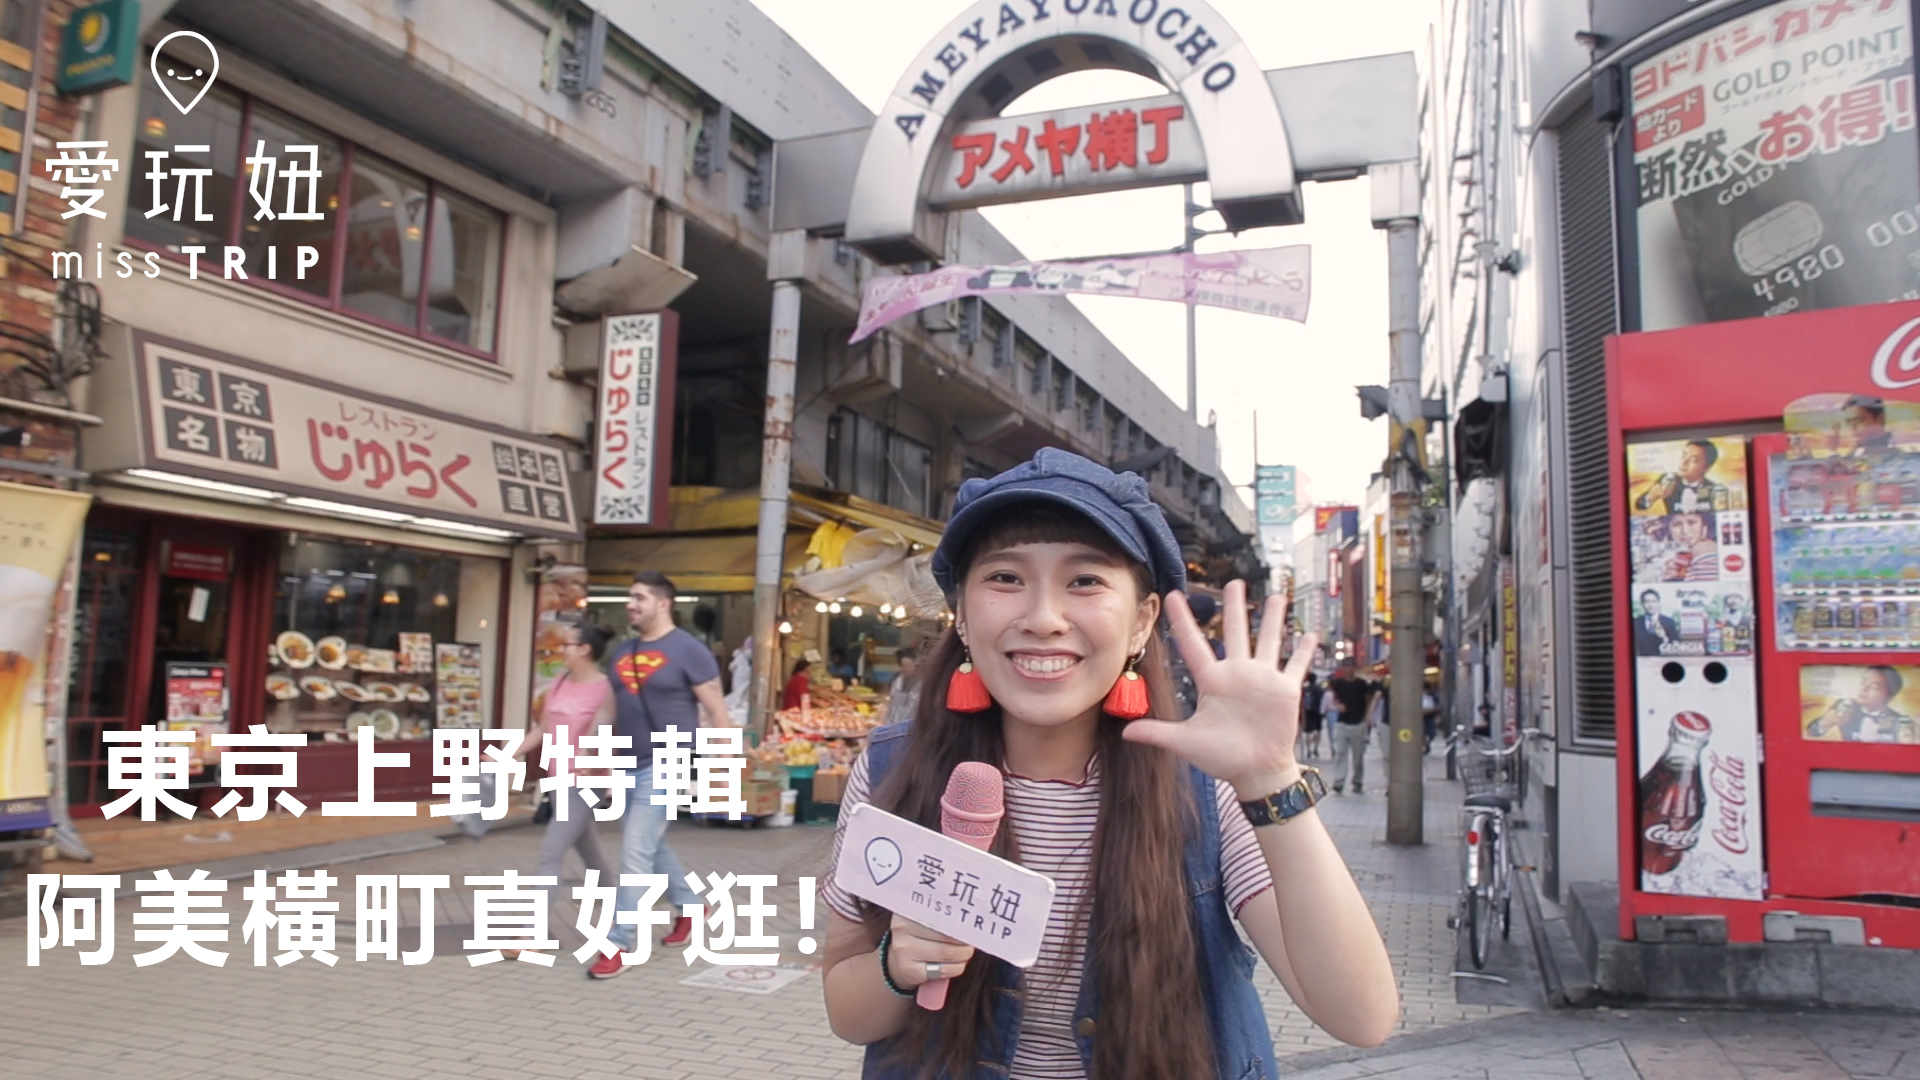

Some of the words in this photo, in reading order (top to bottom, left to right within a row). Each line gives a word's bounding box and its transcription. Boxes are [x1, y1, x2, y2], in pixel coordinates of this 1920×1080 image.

[1712, 60, 1792, 103] GOLD
[1801, 24, 1905, 76] POINT
[952, 105, 1185, 190] アメヤ横丁
[1652, 117, 1682, 144] より
[1717, 166, 1775, 206] GOLD
[1753, 244, 1845, 301] 4980
[1866, 202, 1920, 248] 00
[171, 366, 263, 418] 東京
[338, 401, 438, 441] レストラン
[602, 348, 633, 491] じゅらく
[177, 415, 267, 463] 名物
[306, 418, 479, 509] じゅらく
[632, 411, 649, 490] レストラン
[910, 889, 953, 917] miss
[959, 908, 1014, 941] TRIP
[916, 853, 1022, 924] 愛玩妞
